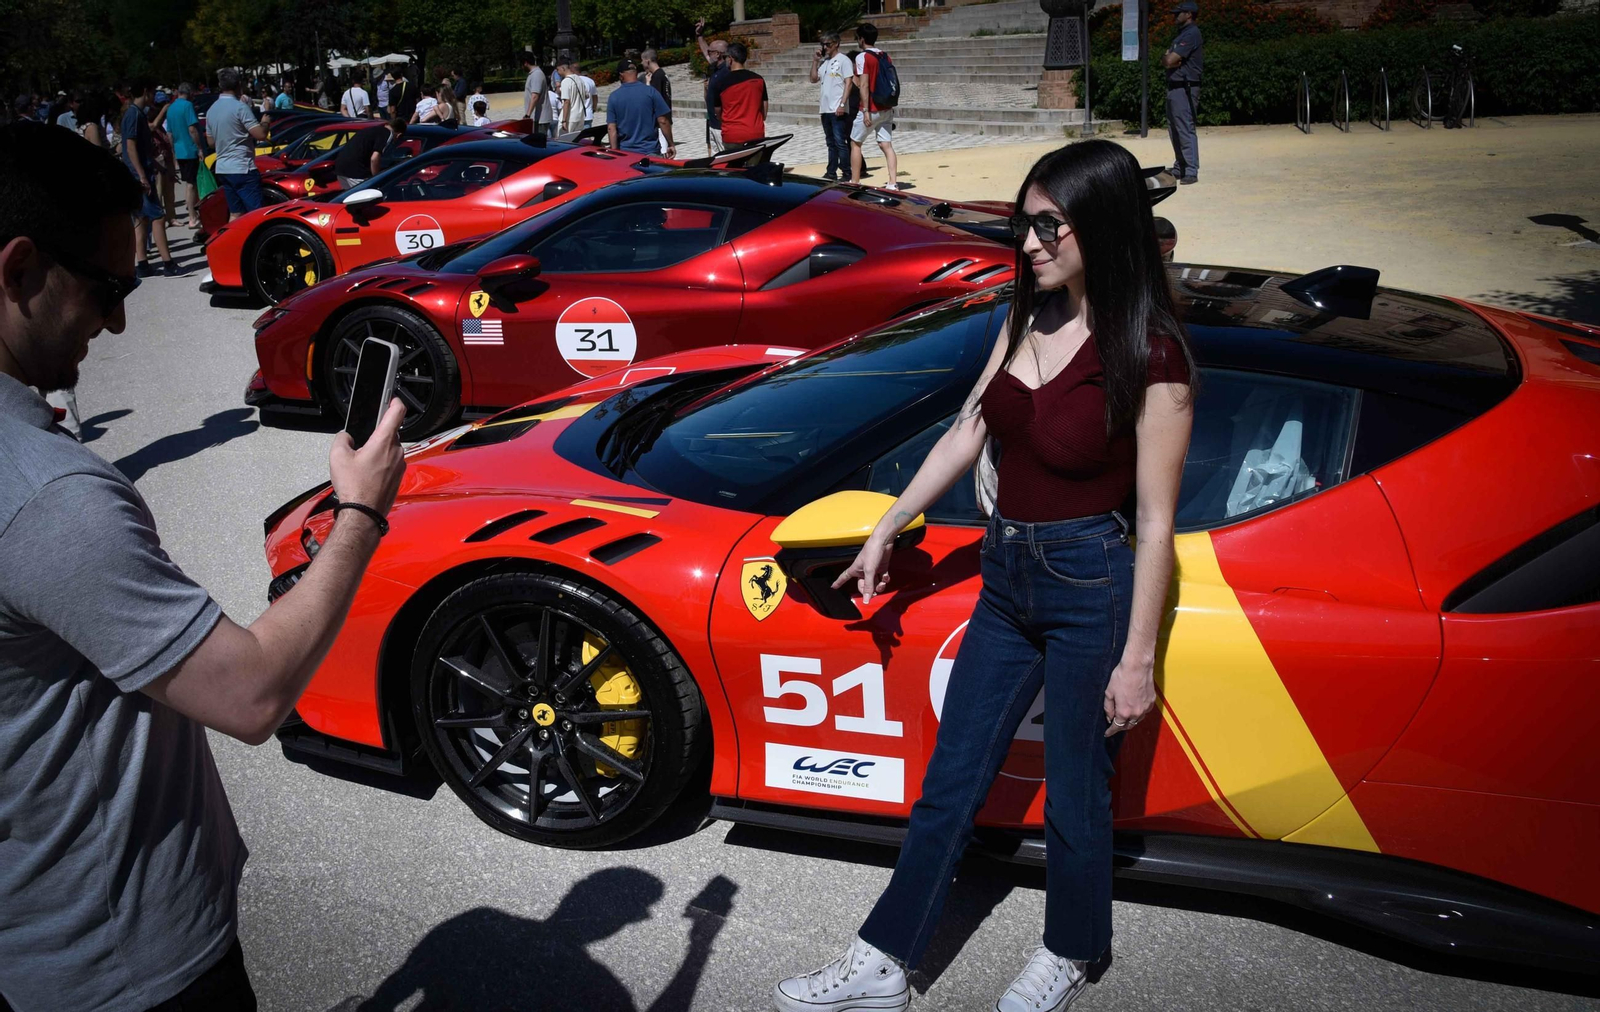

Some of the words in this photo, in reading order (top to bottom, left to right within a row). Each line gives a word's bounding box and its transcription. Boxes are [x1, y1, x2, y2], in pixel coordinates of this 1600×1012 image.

[405, 233, 435, 250] 30
[574, 328, 620, 352] 31
[760, 653, 904, 738] 51
[793, 756, 876, 778] WEC
[792, 779, 842, 790] CHAMPIONSHIP
[804, 775, 828, 783] WORLD
[829, 778, 870, 788] ENDURANCE
